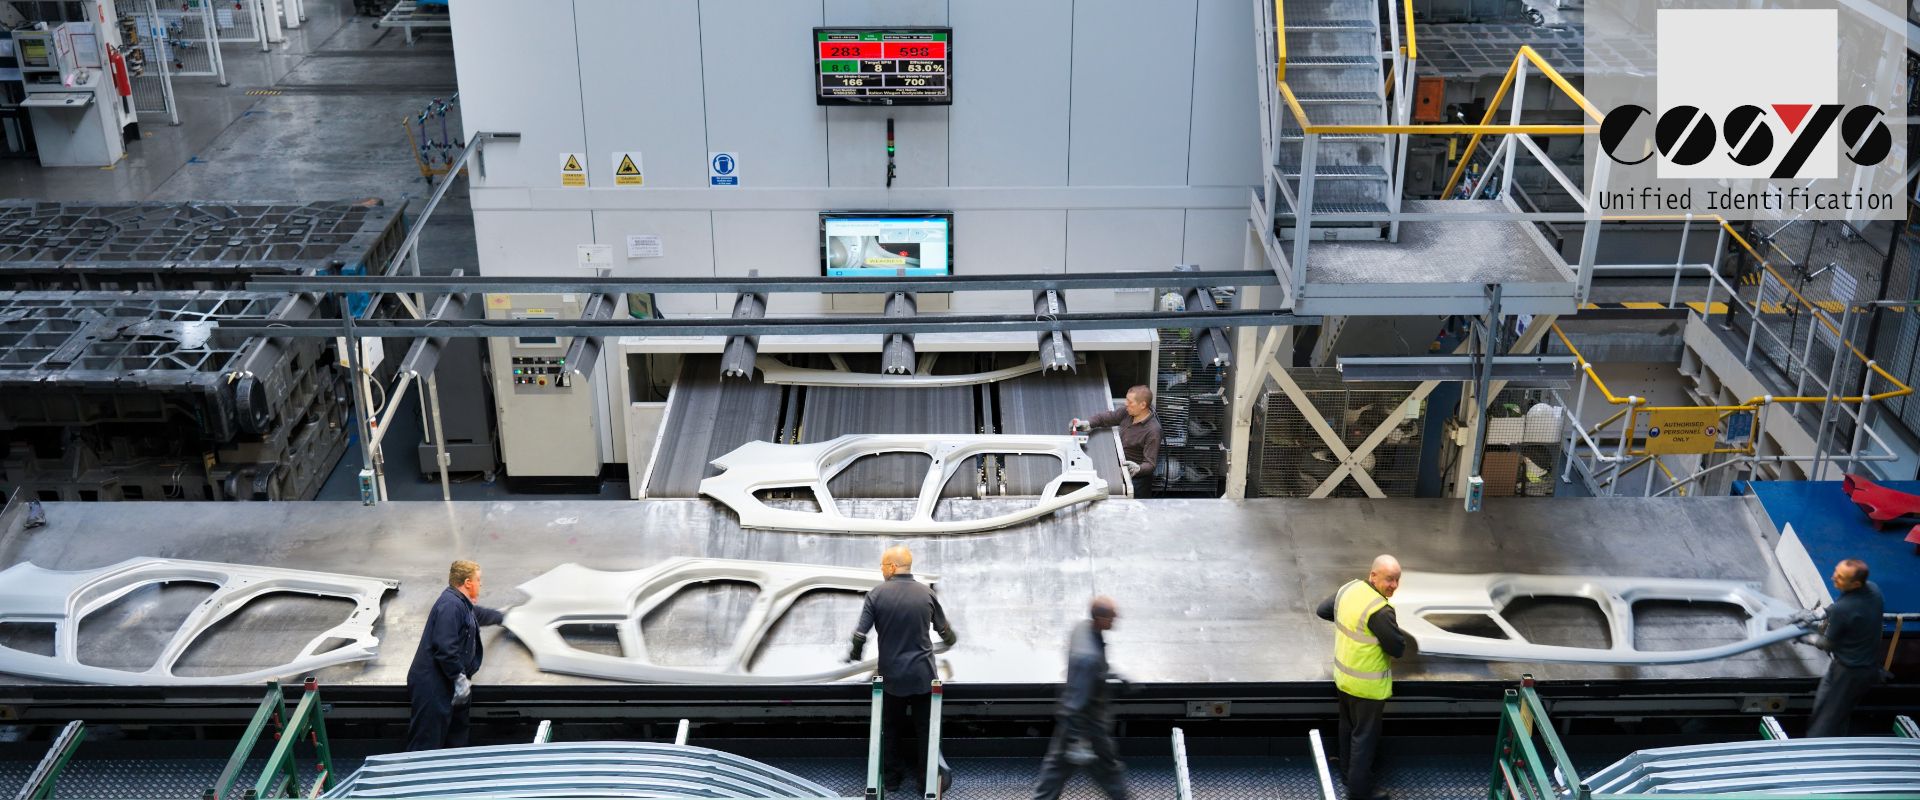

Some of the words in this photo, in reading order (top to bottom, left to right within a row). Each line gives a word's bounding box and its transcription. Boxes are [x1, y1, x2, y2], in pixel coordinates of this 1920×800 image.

[831, 47, 861, 57] 283
[899, 47, 929, 57] 598
[832, 64, 850, 73] 8.6
[874, 64, 883, 72] 8
[842, 78, 863, 86] 166
[904, 78, 925, 86] 700
